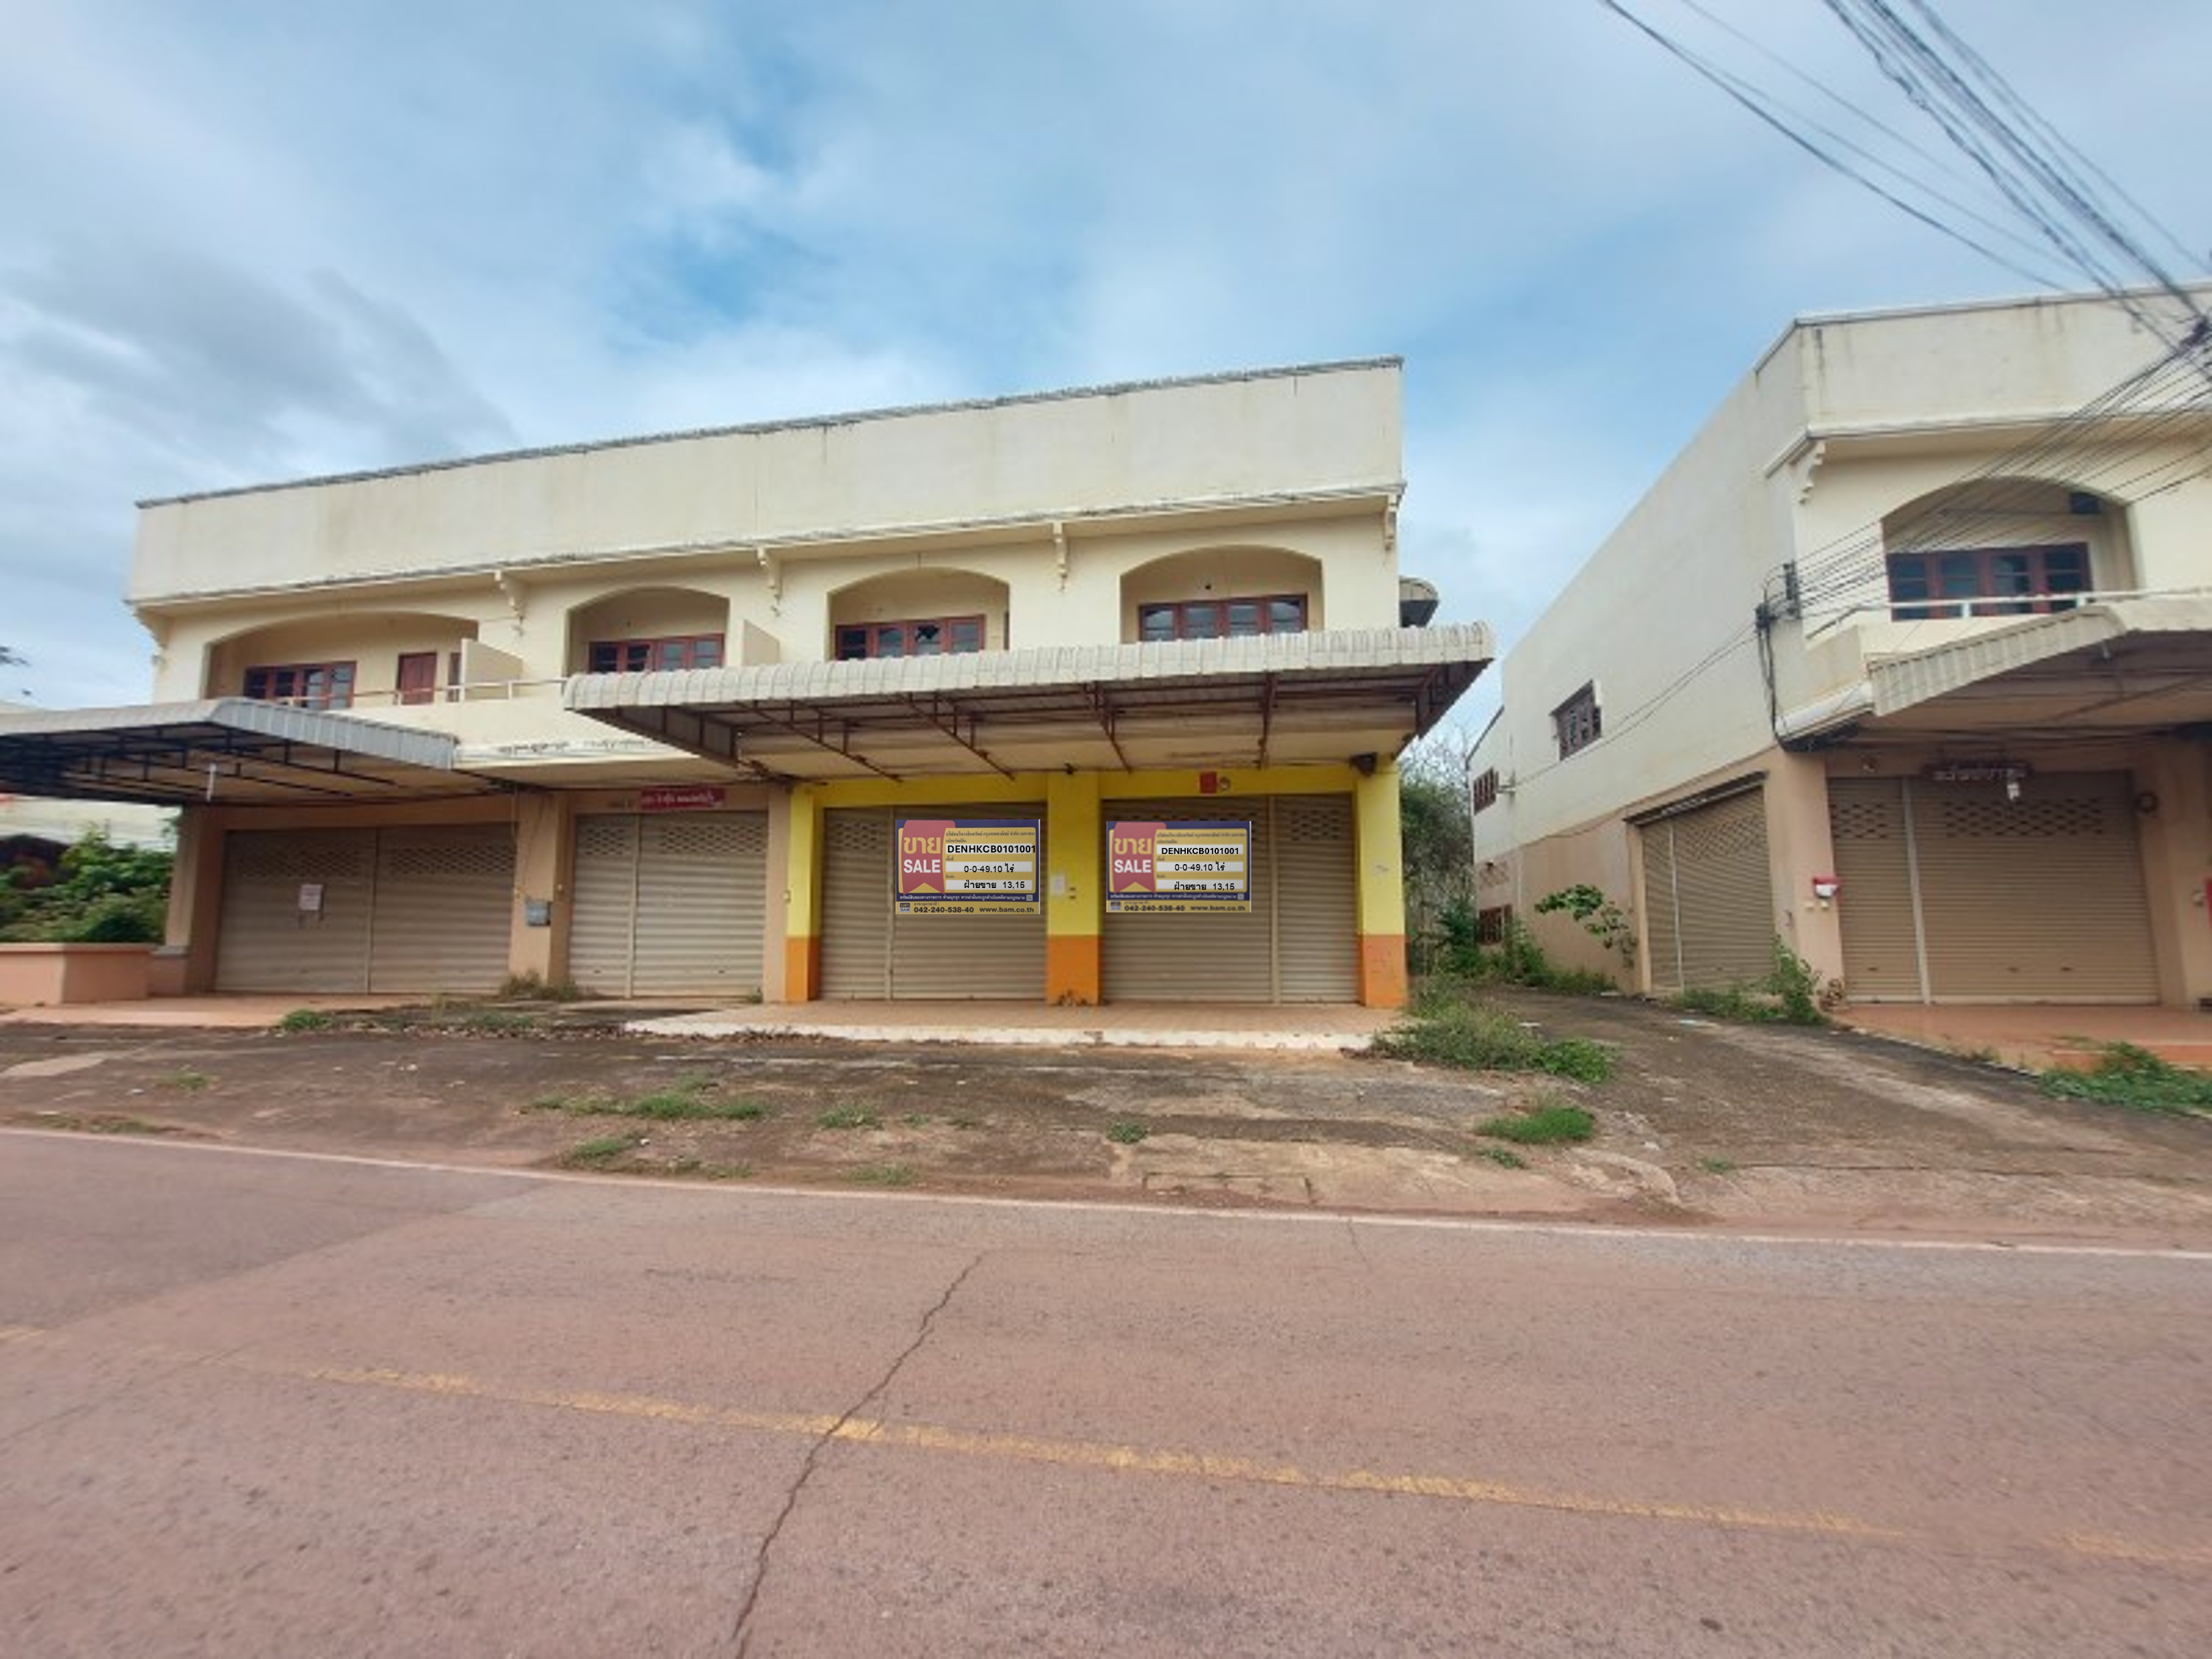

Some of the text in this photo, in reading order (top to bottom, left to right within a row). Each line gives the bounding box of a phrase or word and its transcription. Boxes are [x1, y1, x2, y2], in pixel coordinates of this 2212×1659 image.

[904, 837, 941, 854] ขาย
[947, 845, 1036, 853] DENHKCB0101001
[1114, 838, 1152, 855] ขาย
[904, 859, 940, 873] SALE
[1004, 863, 1015, 873] ไร่
[1114, 859, 1152, 873] SALE
[1174, 861, 1225, 871] 0-0-49.10 ไร่
[964, 879, 1025, 889] ฝ่ายขาย 13,15
[1174, 881, 1235, 891] ฝ่ายขาย 13,15
